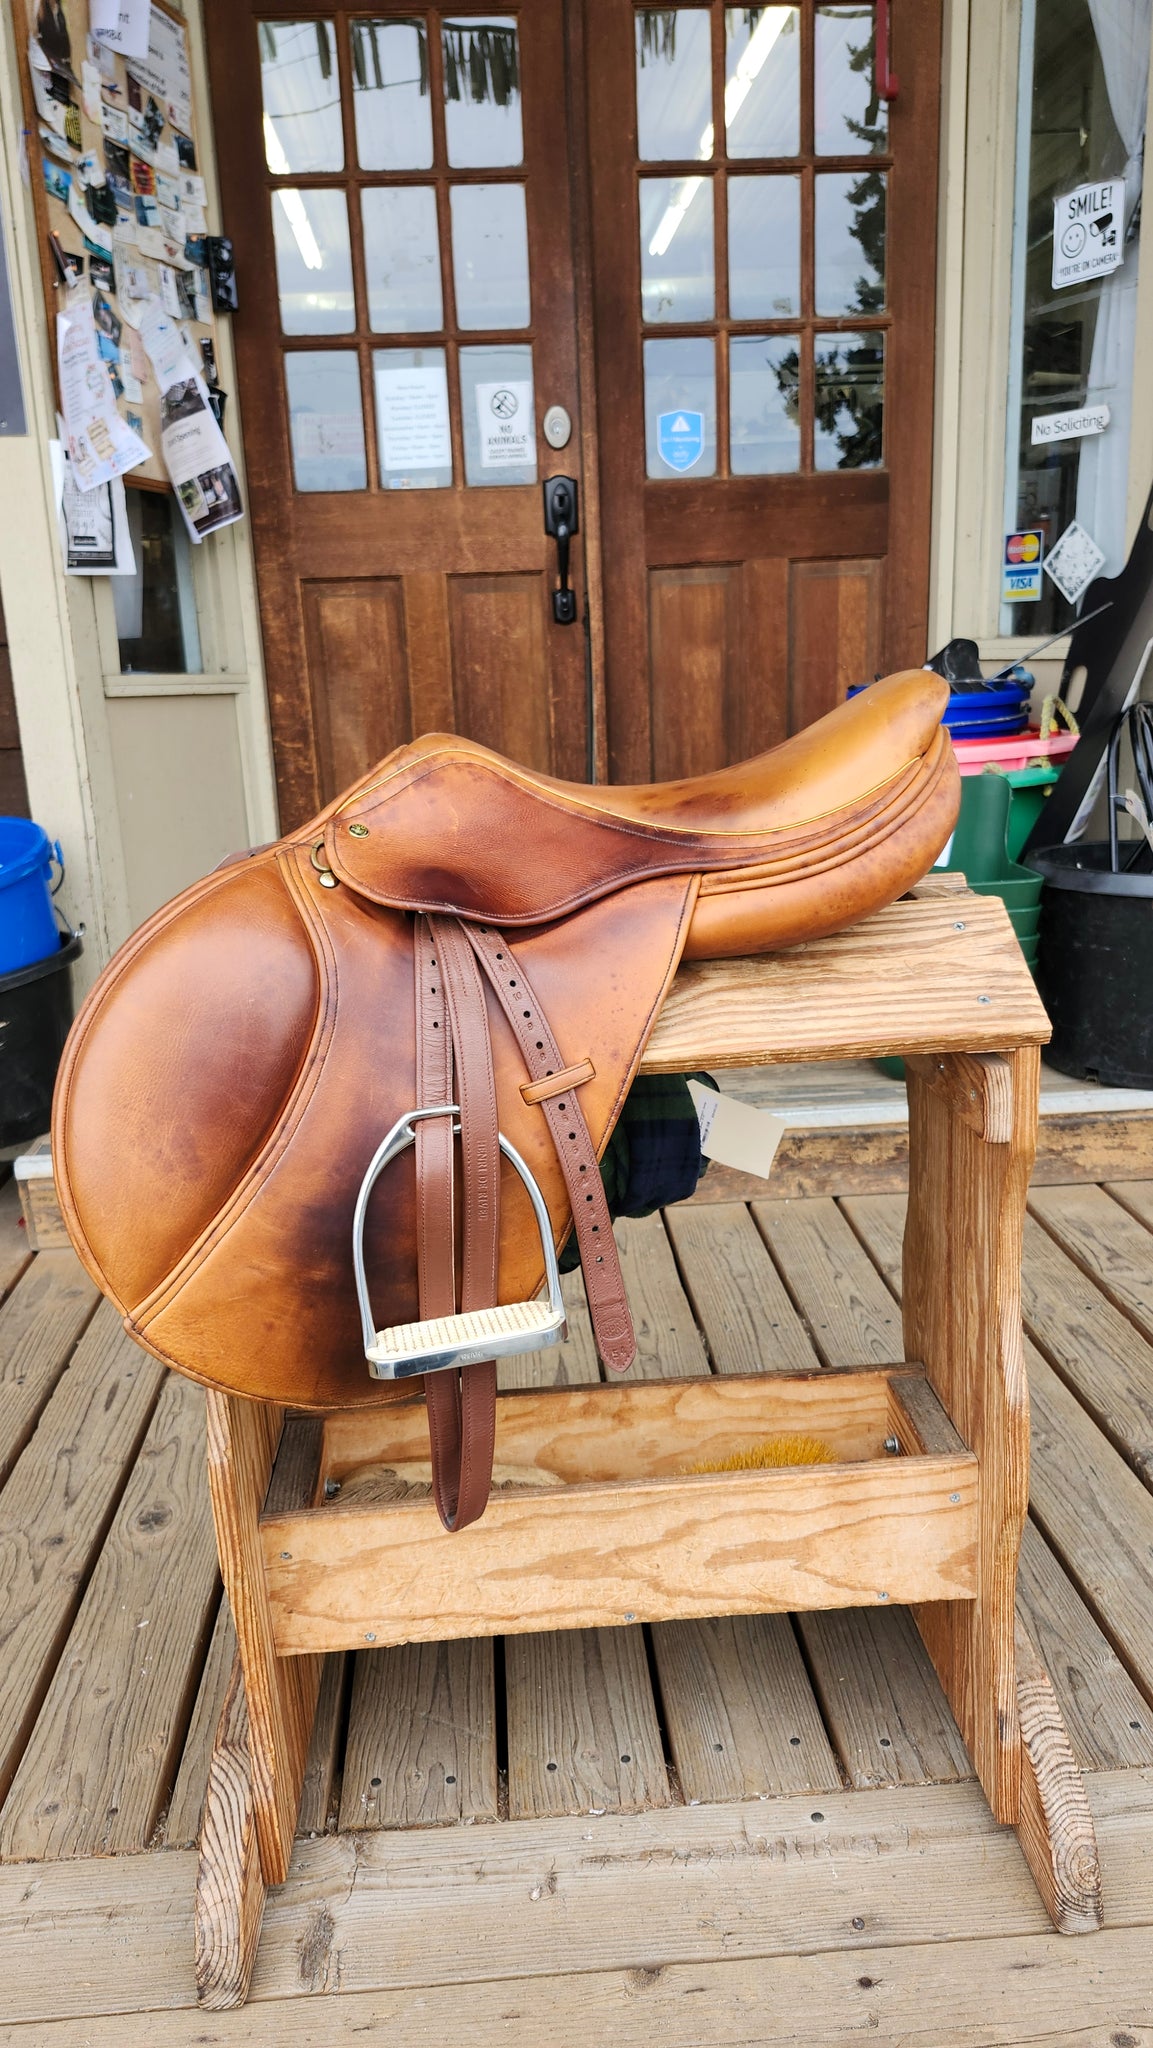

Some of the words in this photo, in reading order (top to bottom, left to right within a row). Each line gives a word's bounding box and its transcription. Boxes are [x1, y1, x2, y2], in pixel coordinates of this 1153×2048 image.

[1068, 186, 1112, 220] SMILE!
[1036, 423, 1051, 437] No
[1054, 416, 1104, 434] Soliciting
[1010, 577, 1032, 590] VISA
